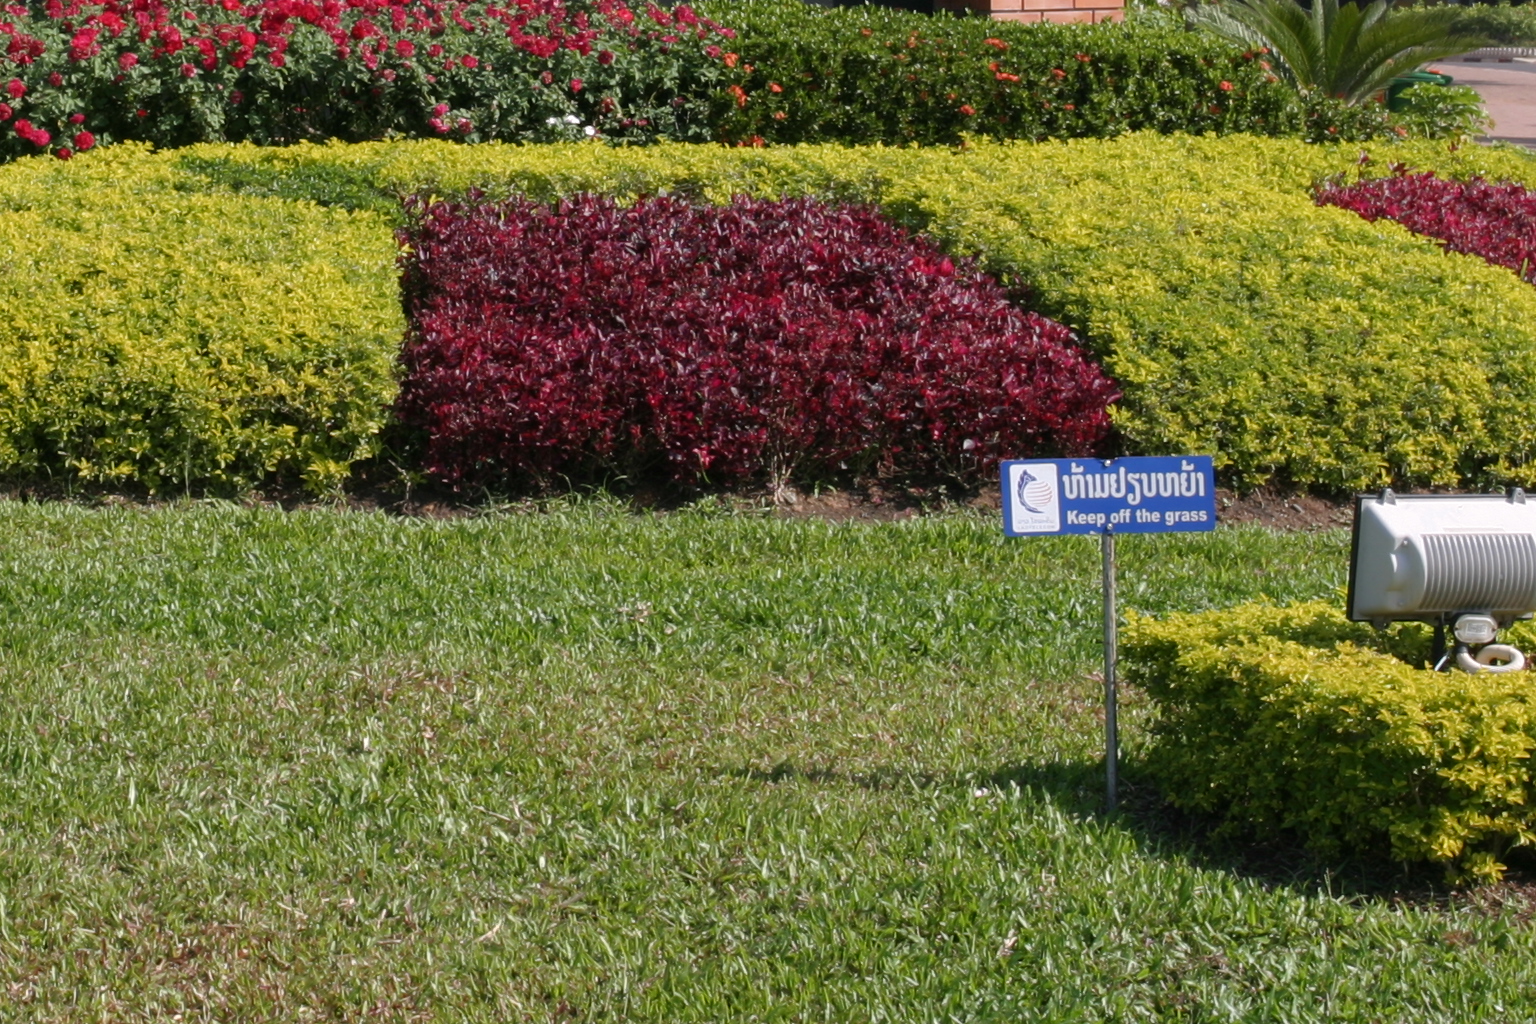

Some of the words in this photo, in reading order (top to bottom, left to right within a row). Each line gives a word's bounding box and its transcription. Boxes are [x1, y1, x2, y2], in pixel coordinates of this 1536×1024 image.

[1066, 510, 1106, 528] Keep
[1109, 508, 1132, 524] off
[1135, 508, 1161, 523] the
[1164, 509, 1209, 527] grass
